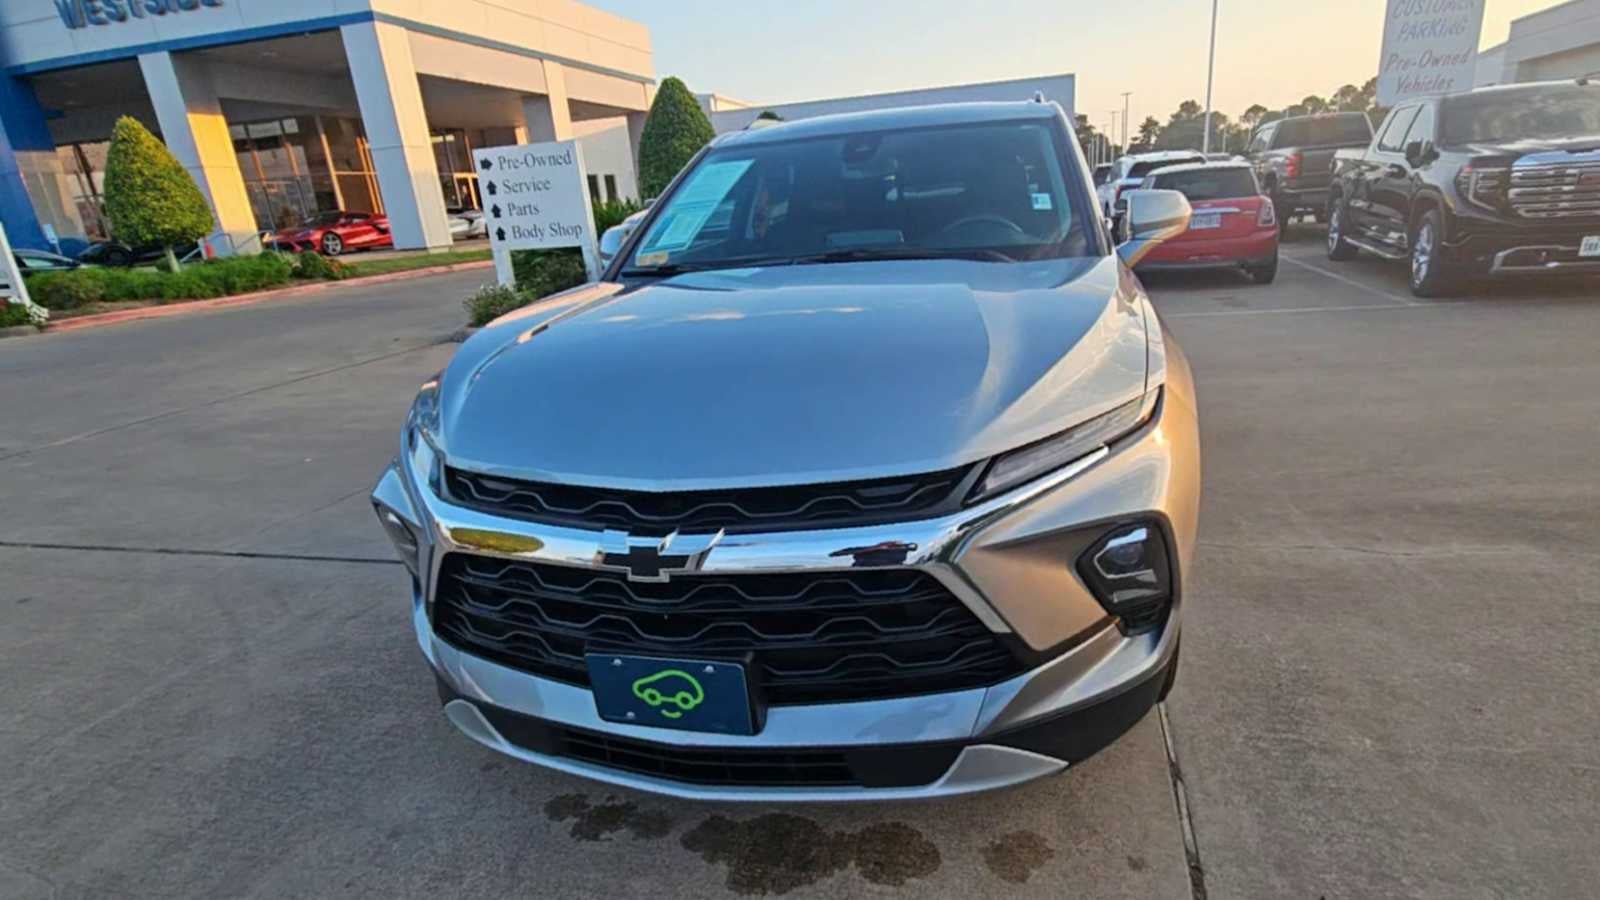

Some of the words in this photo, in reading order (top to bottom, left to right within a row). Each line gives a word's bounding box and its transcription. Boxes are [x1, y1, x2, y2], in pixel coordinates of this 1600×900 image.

[54, 0, 223, 29] WESTS
[1384, 46, 1473, 72] Pre-Owned
[1395, 73, 1456, 95] Vehicles
[497, 150, 572, 170] Pre-Owned
[502, 179, 551, 193] Service
[507, 203, 540, 216] Parts
[511, 224, 544, 241] Body
[549, 222, 583, 239] Shop
